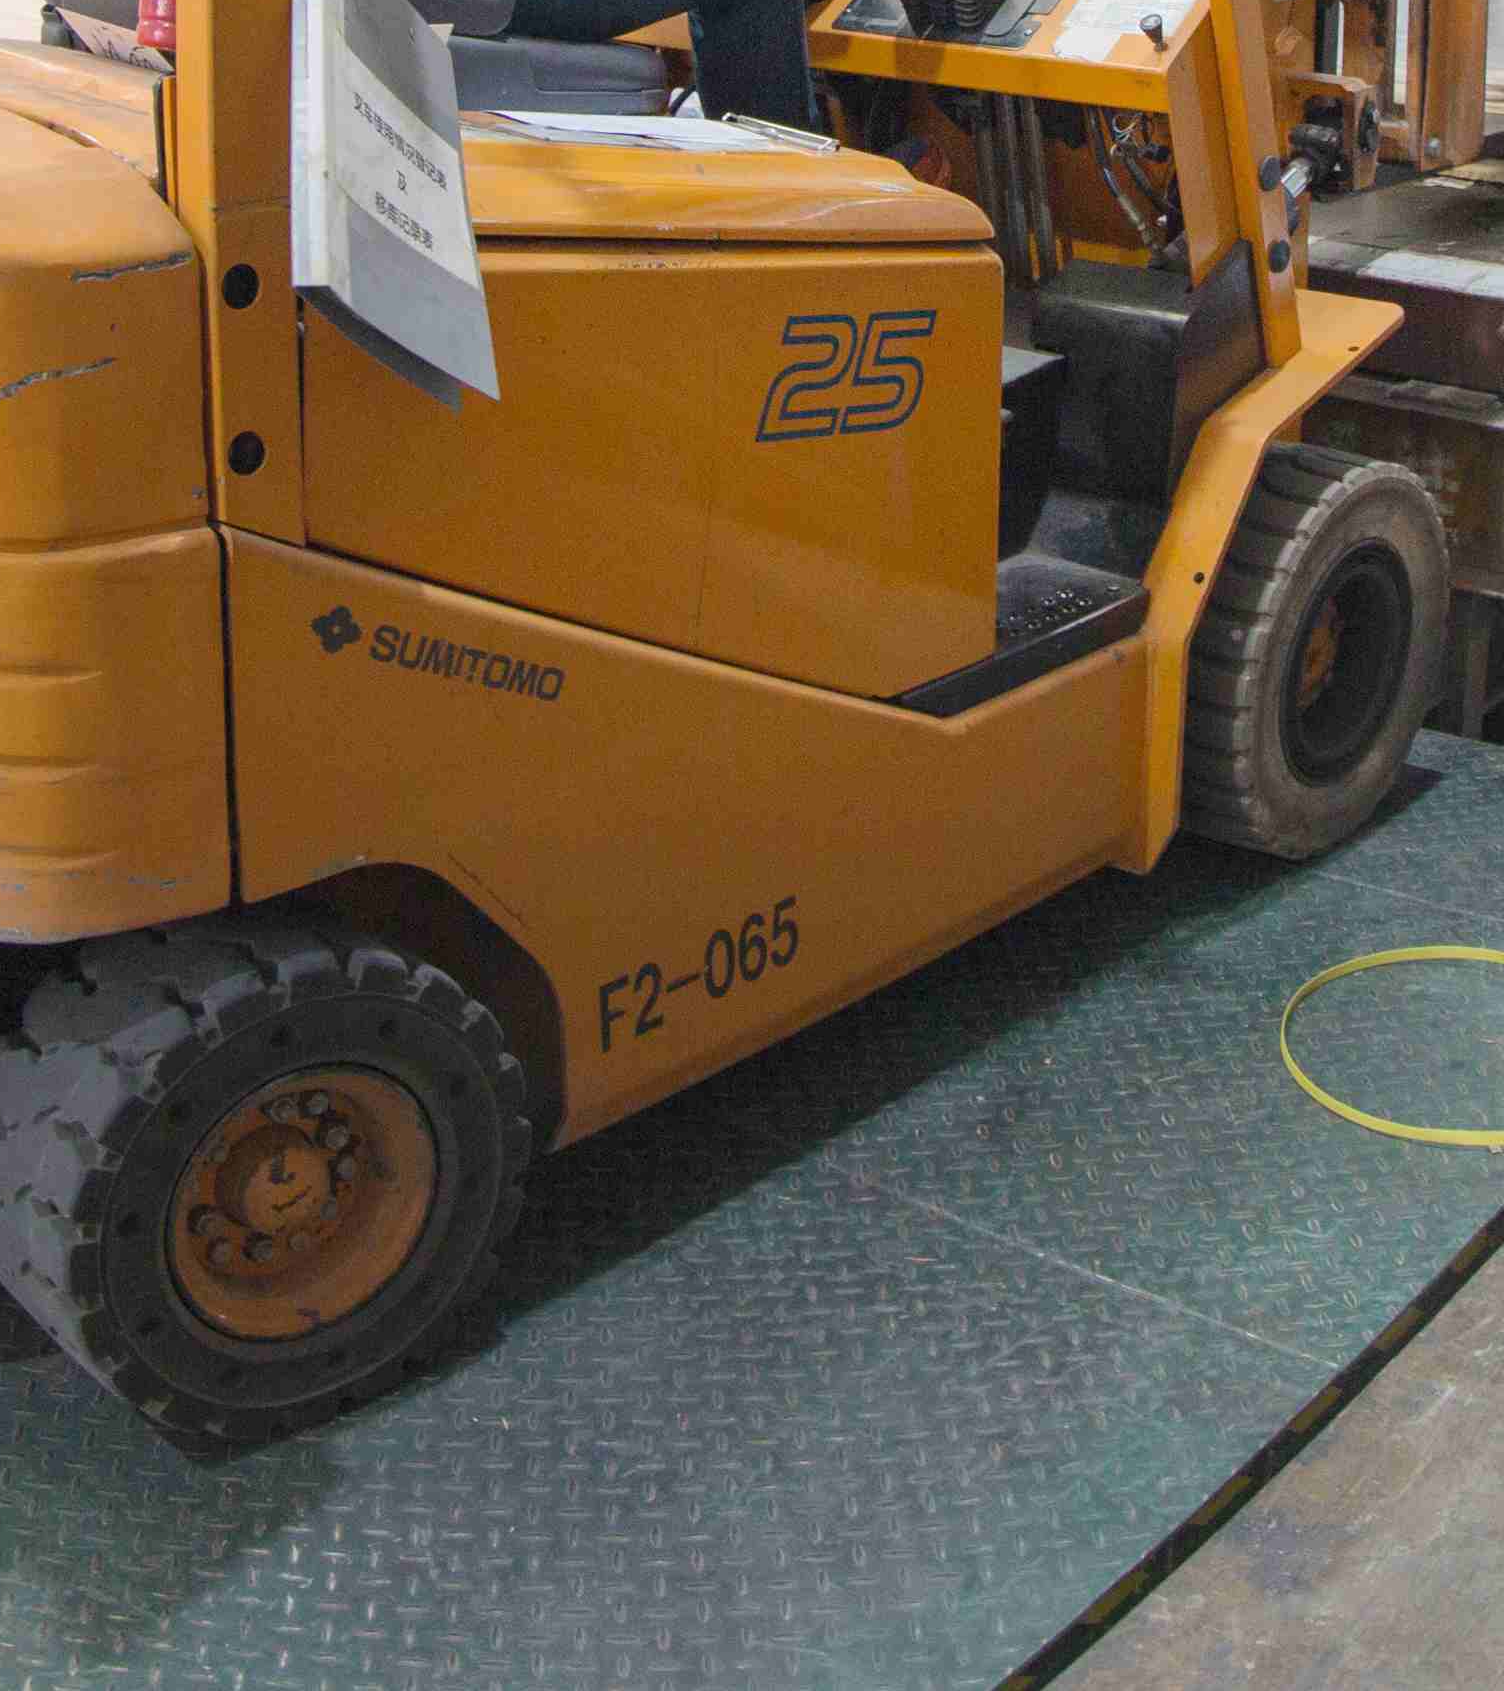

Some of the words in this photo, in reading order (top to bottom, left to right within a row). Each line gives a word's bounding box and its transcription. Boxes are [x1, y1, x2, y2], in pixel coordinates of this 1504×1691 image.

[755, 309, 937, 443] 25
[369, 624, 564, 701] SUMITOMO
[599, 895, 799, 1053] F2-065
